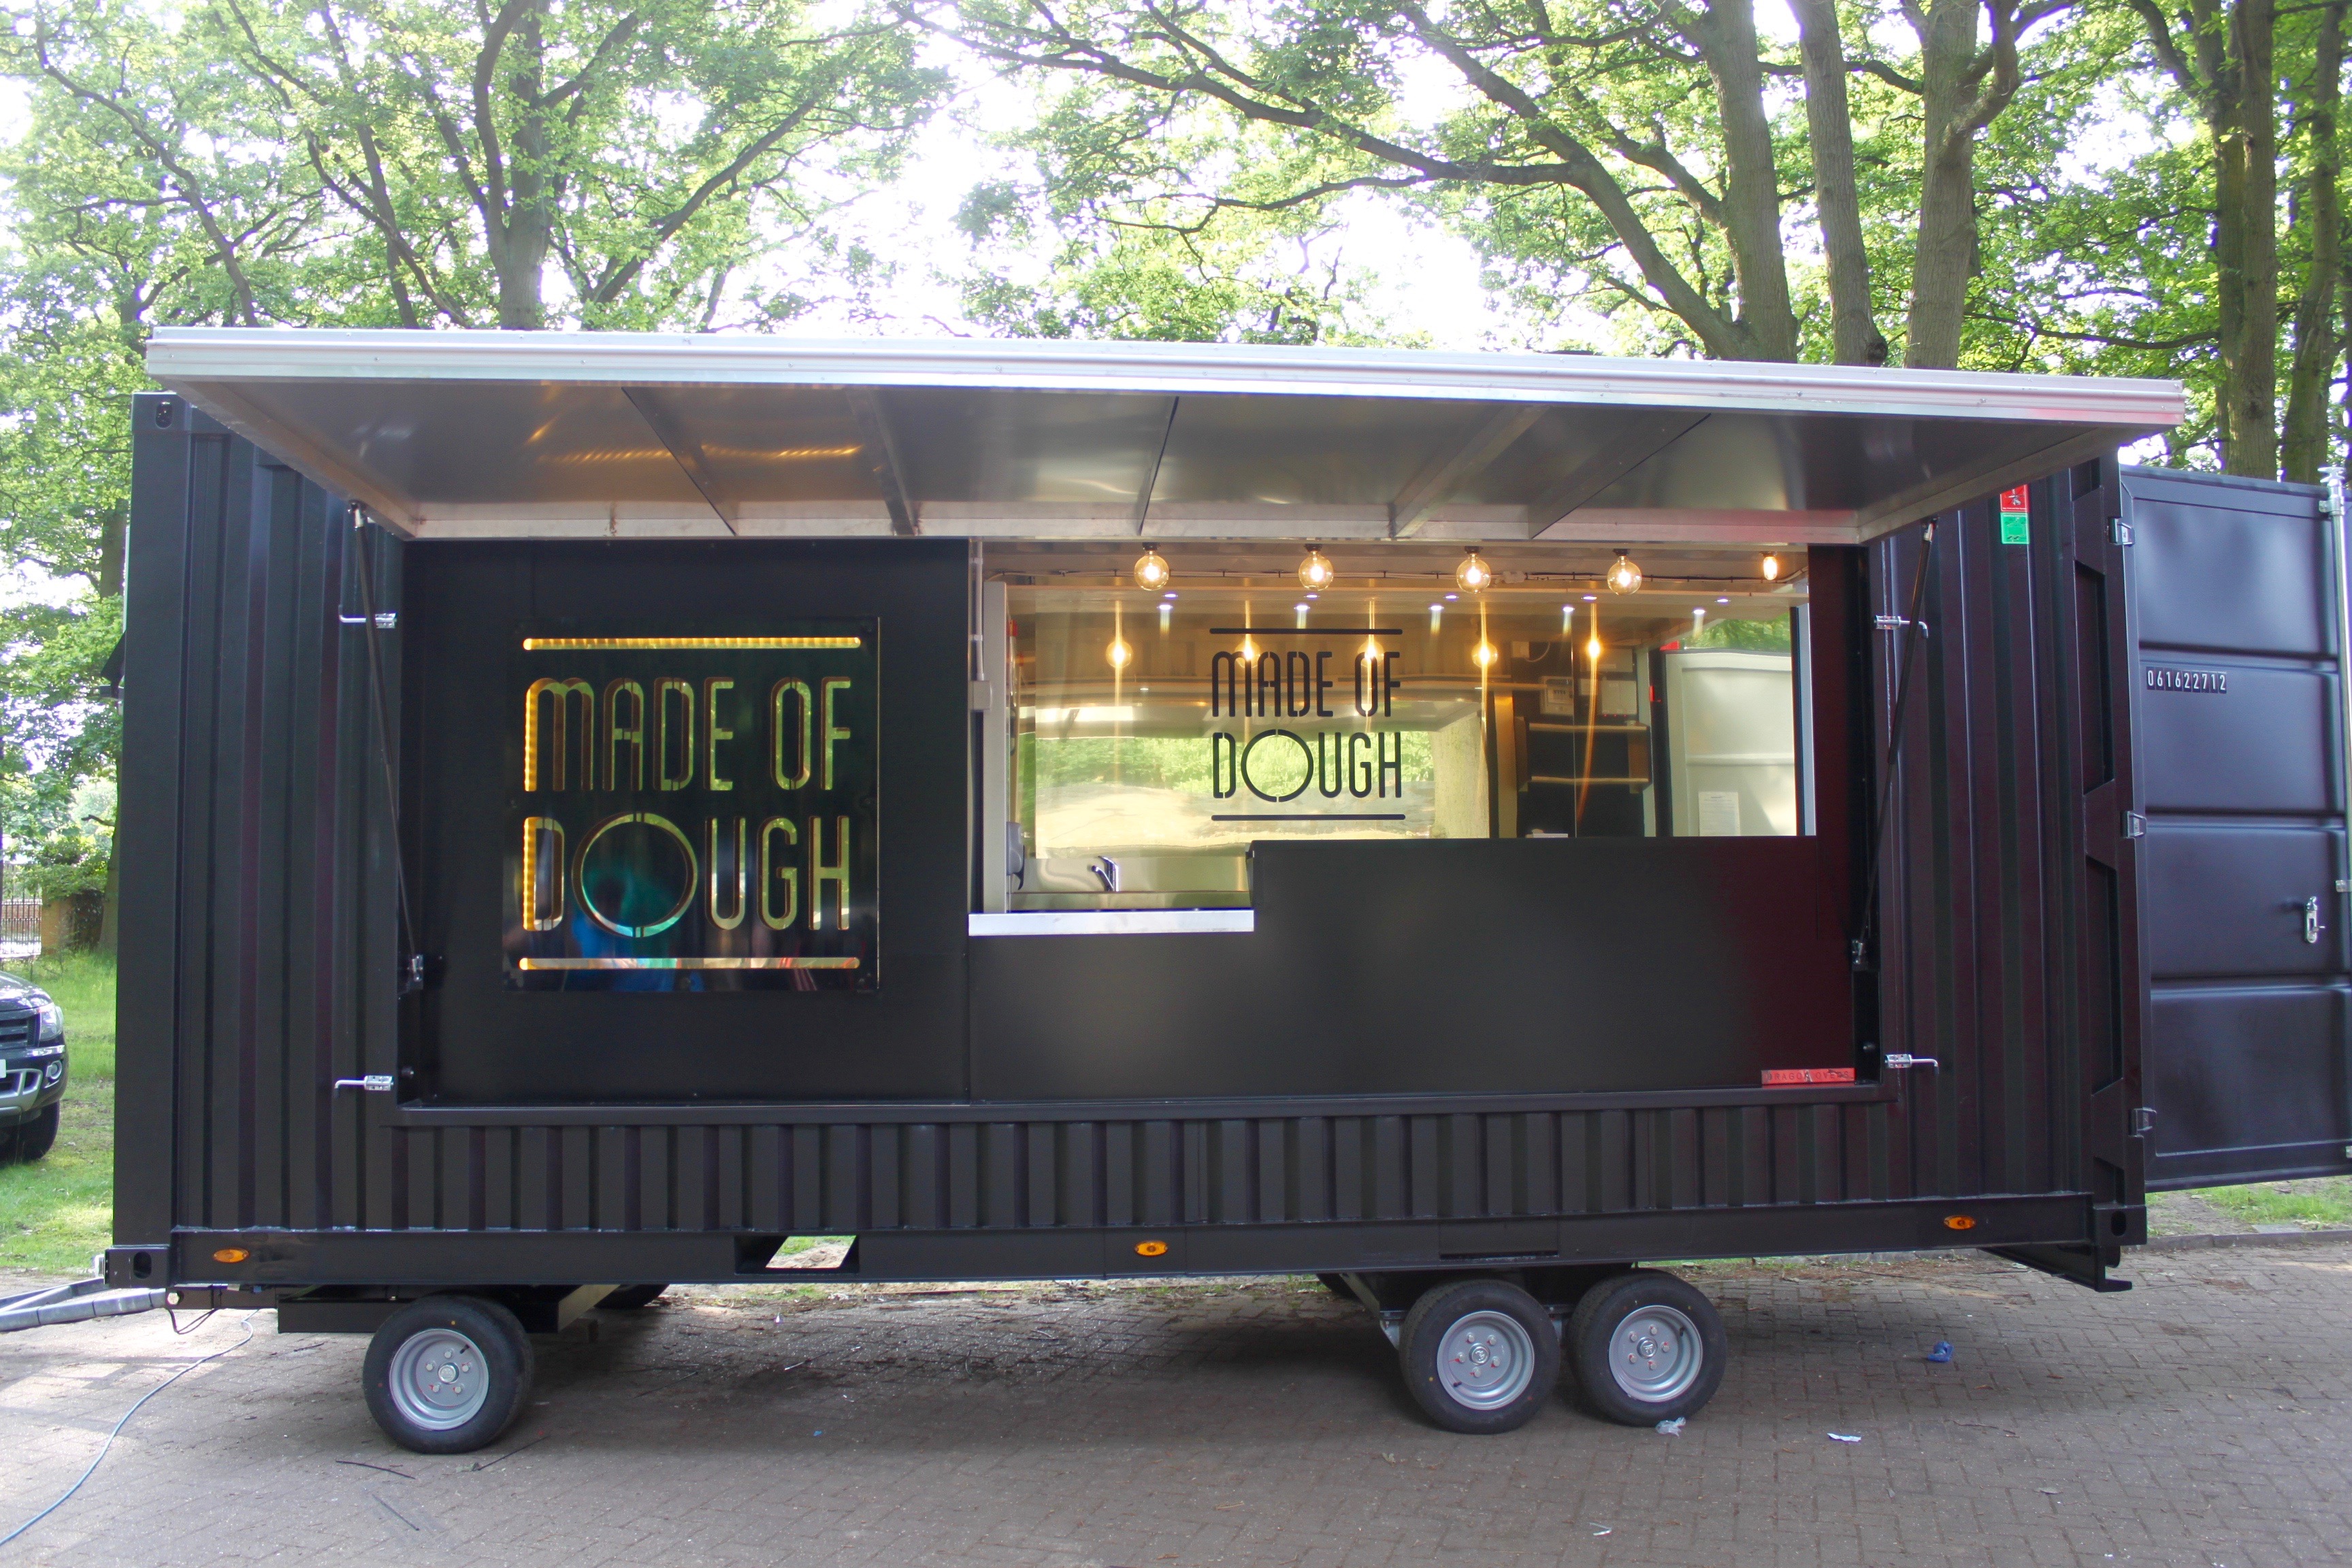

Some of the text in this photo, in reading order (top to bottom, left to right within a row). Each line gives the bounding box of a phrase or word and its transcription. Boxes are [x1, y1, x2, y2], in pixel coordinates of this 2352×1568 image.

[1211, 651, 1401, 717] MADE OF
[2147, 670, 2226, 691] 061622712
[523, 677, 851, 791] MADE OF
[1212, 729, 1402, 802] DOUGH
[522, 812, 850, 938] DOUGH
